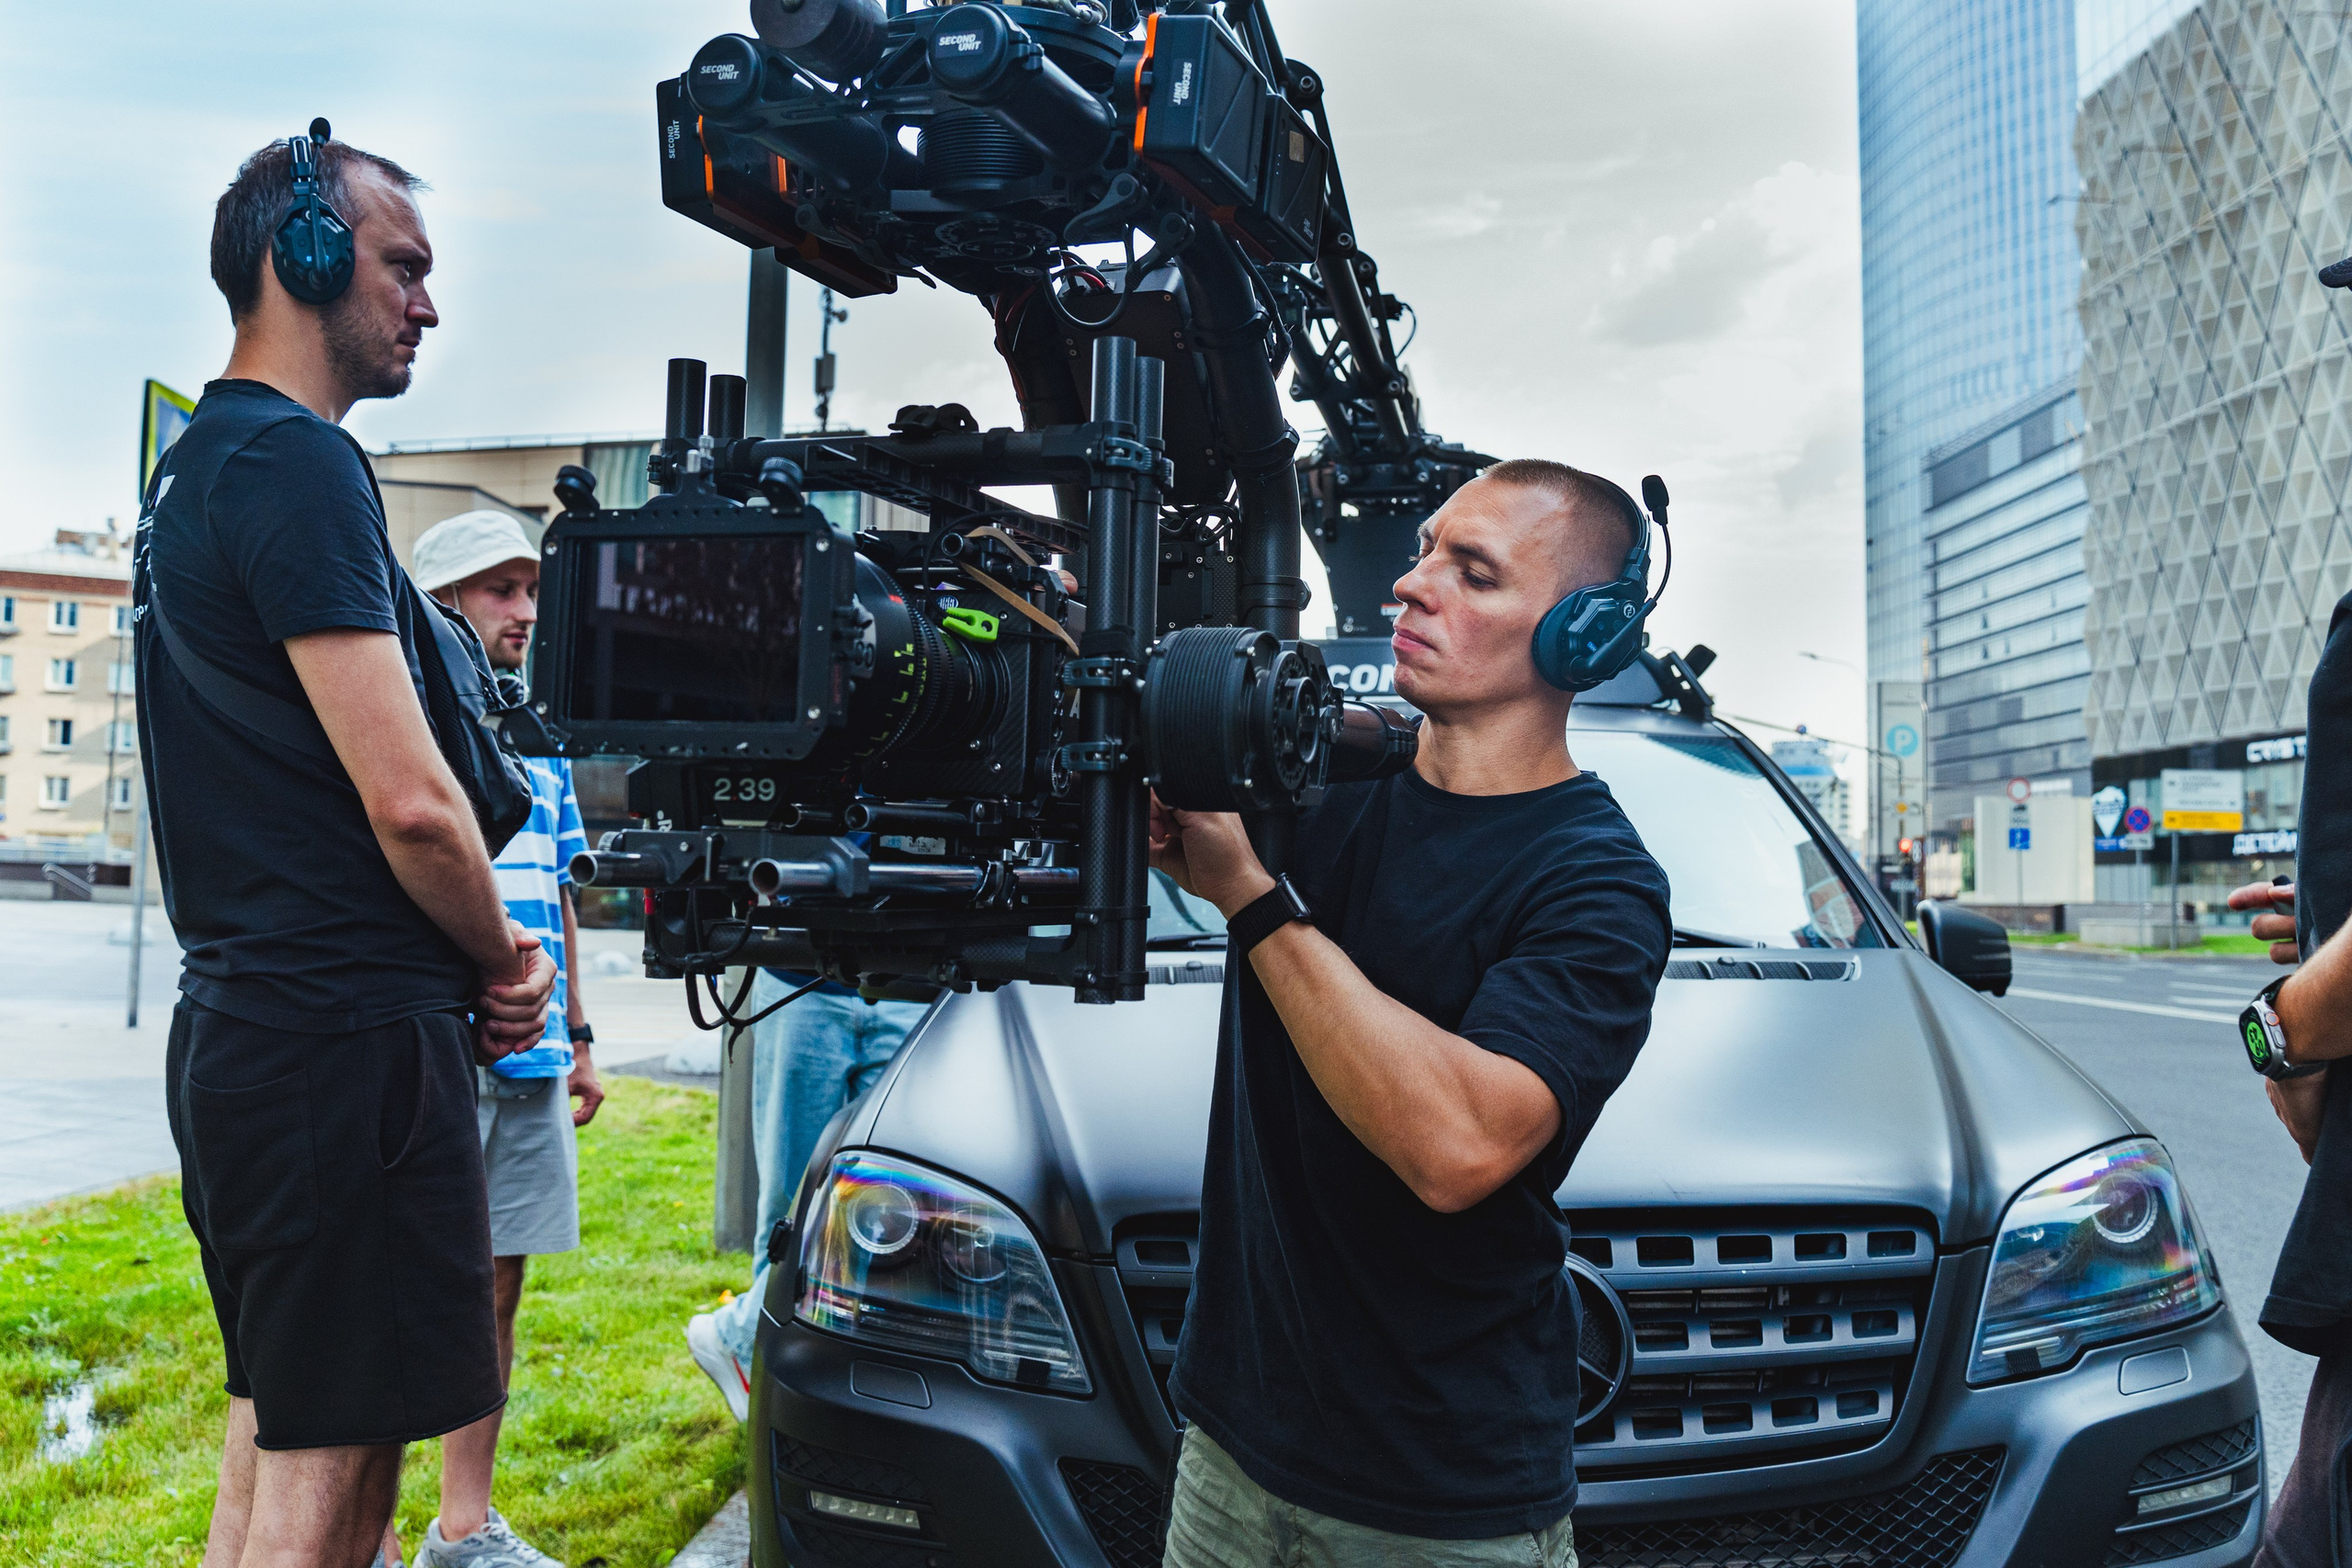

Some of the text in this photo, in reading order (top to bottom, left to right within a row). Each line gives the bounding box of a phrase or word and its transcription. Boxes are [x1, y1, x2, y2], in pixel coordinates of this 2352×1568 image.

[939, 33, 977, 46] SECOND
[958, 40, 982, 51] UNIT
[700, 63, 735, 74] SECOND
[718, 71, 740, 80] UNIT
[1182, 62, 1193, 100] SECOND
[1172, 82, 1182, 106] UNIT
[673, 119, 681, 140] UNIT
[667, 125, 676, 159] SECOND
